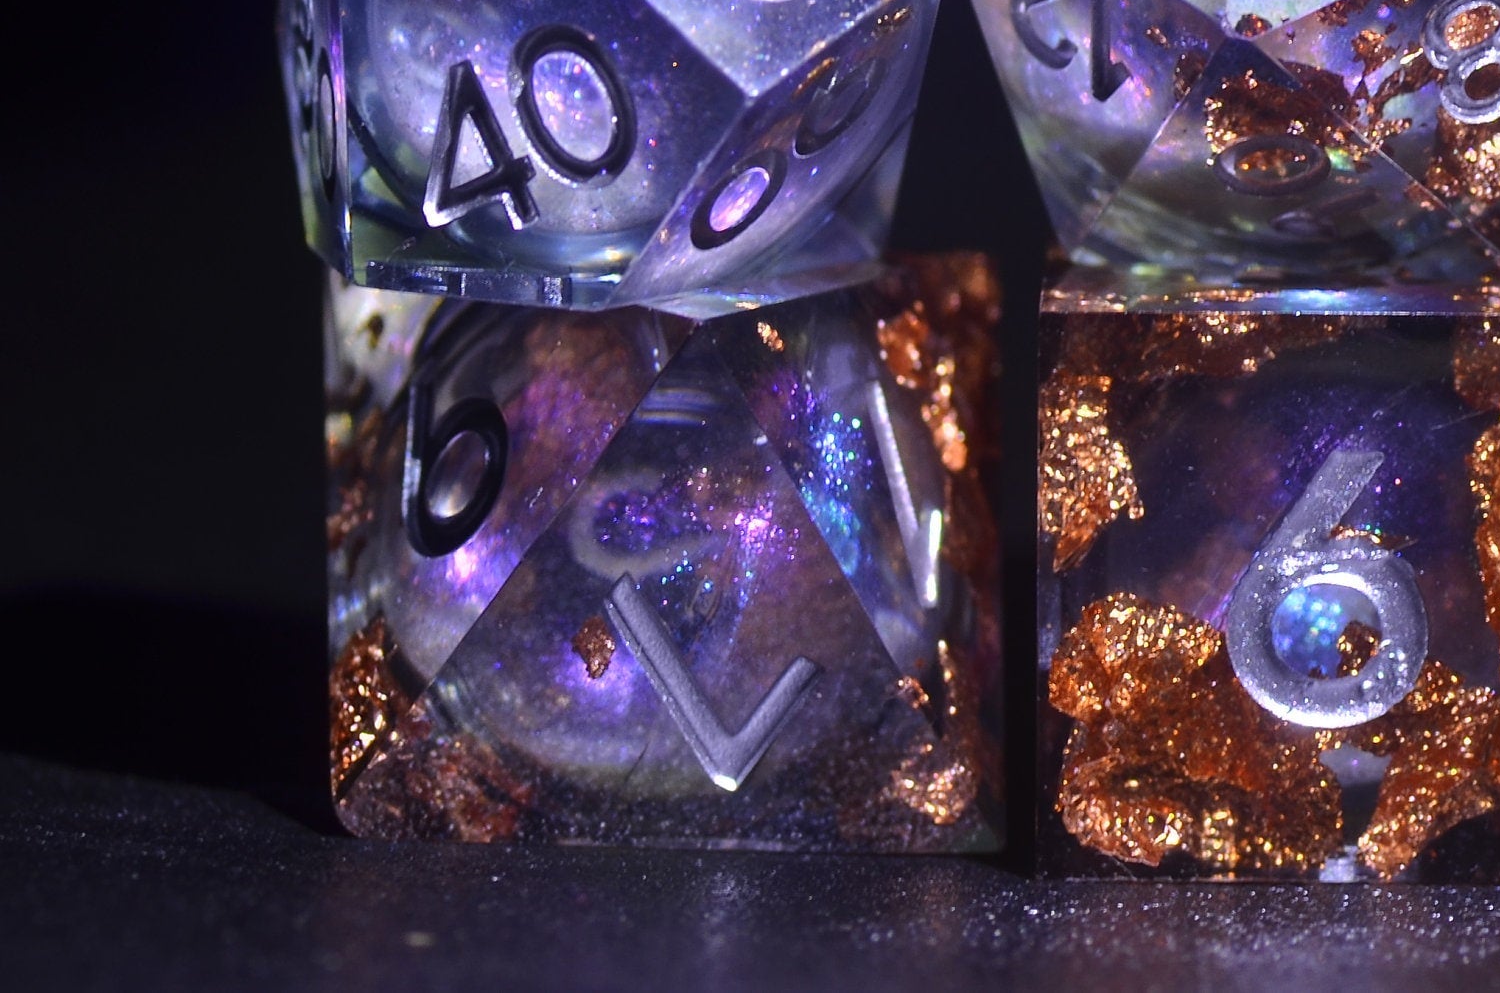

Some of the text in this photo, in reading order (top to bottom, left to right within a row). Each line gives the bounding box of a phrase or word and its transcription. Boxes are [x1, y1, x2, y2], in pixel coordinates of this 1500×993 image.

[423, 22, 637, 231] 40
[401, 375, 509, 559] 6
[1227, 450, 1430, 730] 6
